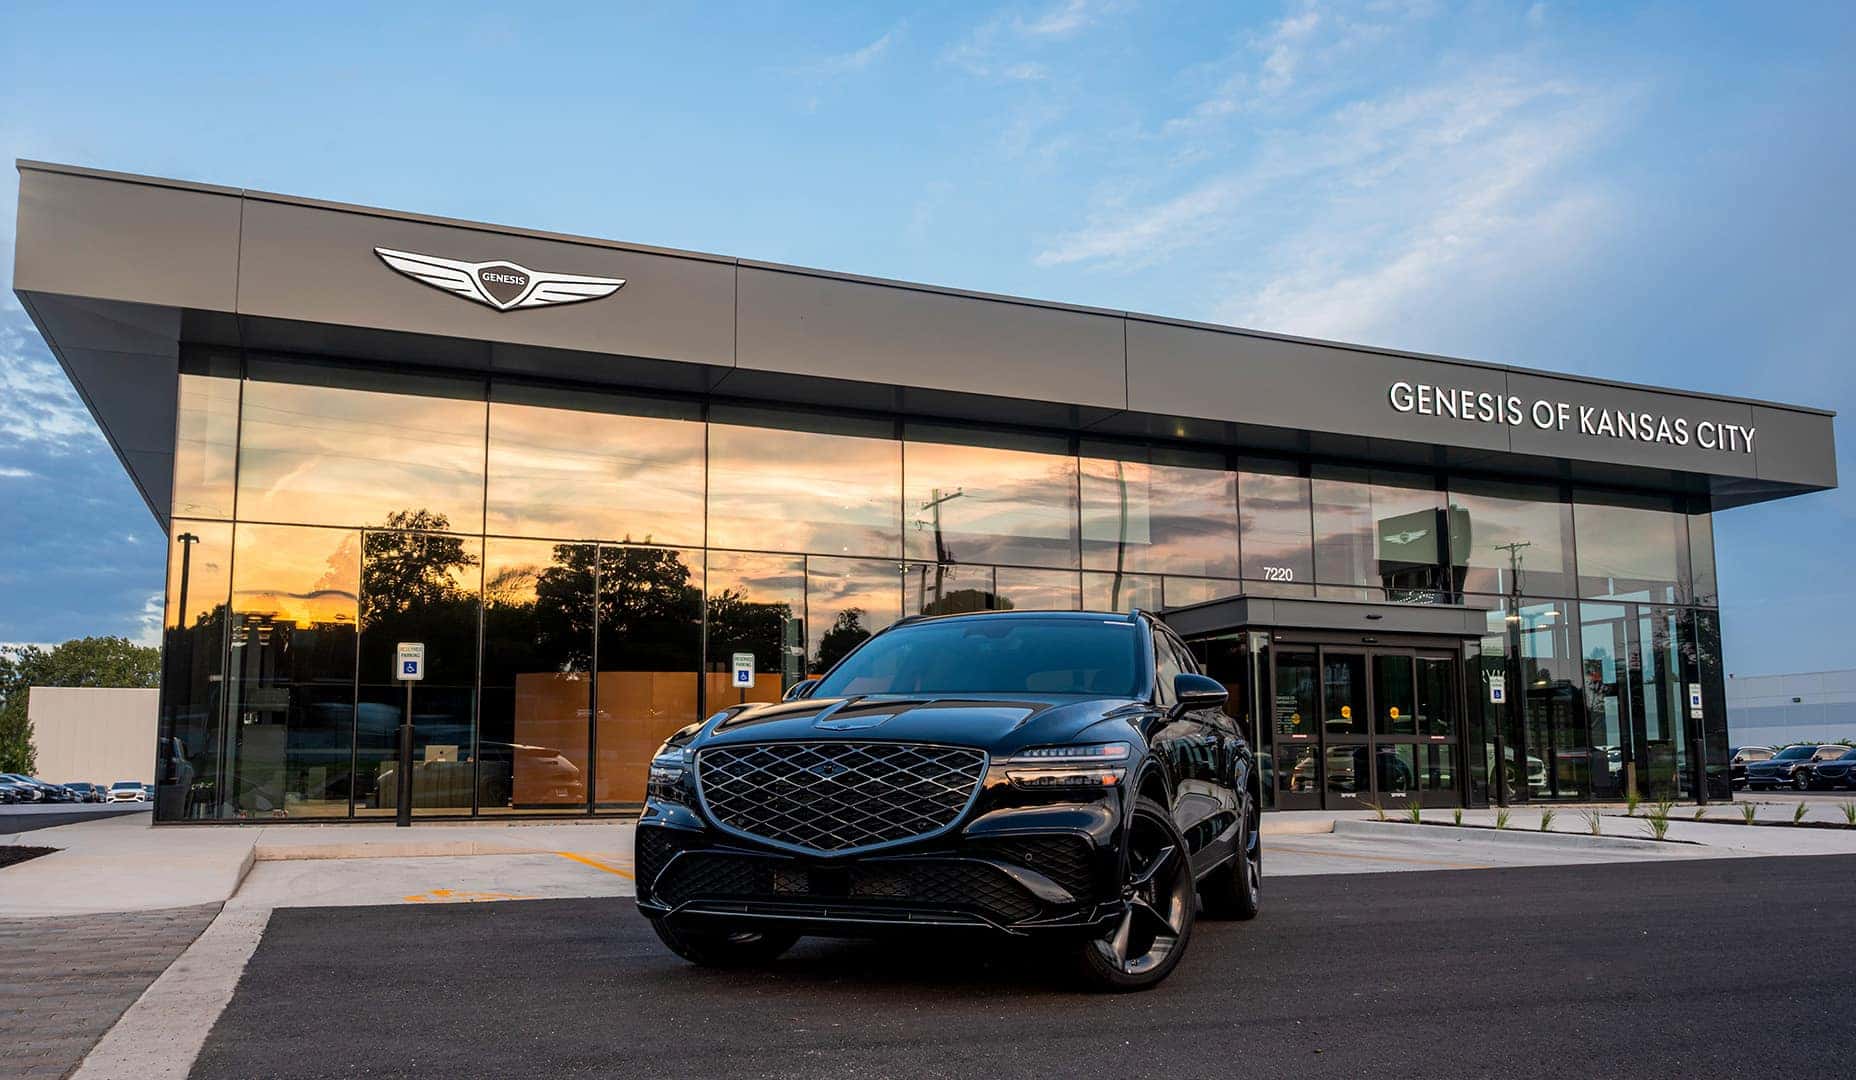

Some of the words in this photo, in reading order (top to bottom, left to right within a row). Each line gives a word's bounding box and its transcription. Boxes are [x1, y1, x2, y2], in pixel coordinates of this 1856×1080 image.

[482, 272, 525, 285] GENESIS
[1390, 382, 1523, 426] GENESIS
[1532, 400, 1570, 430] OF
[1579, 406, 1689, 446] KANSAS
[1697, 421, 1755, 453] CITY
[1263, 566, 1293, 582] 7220
